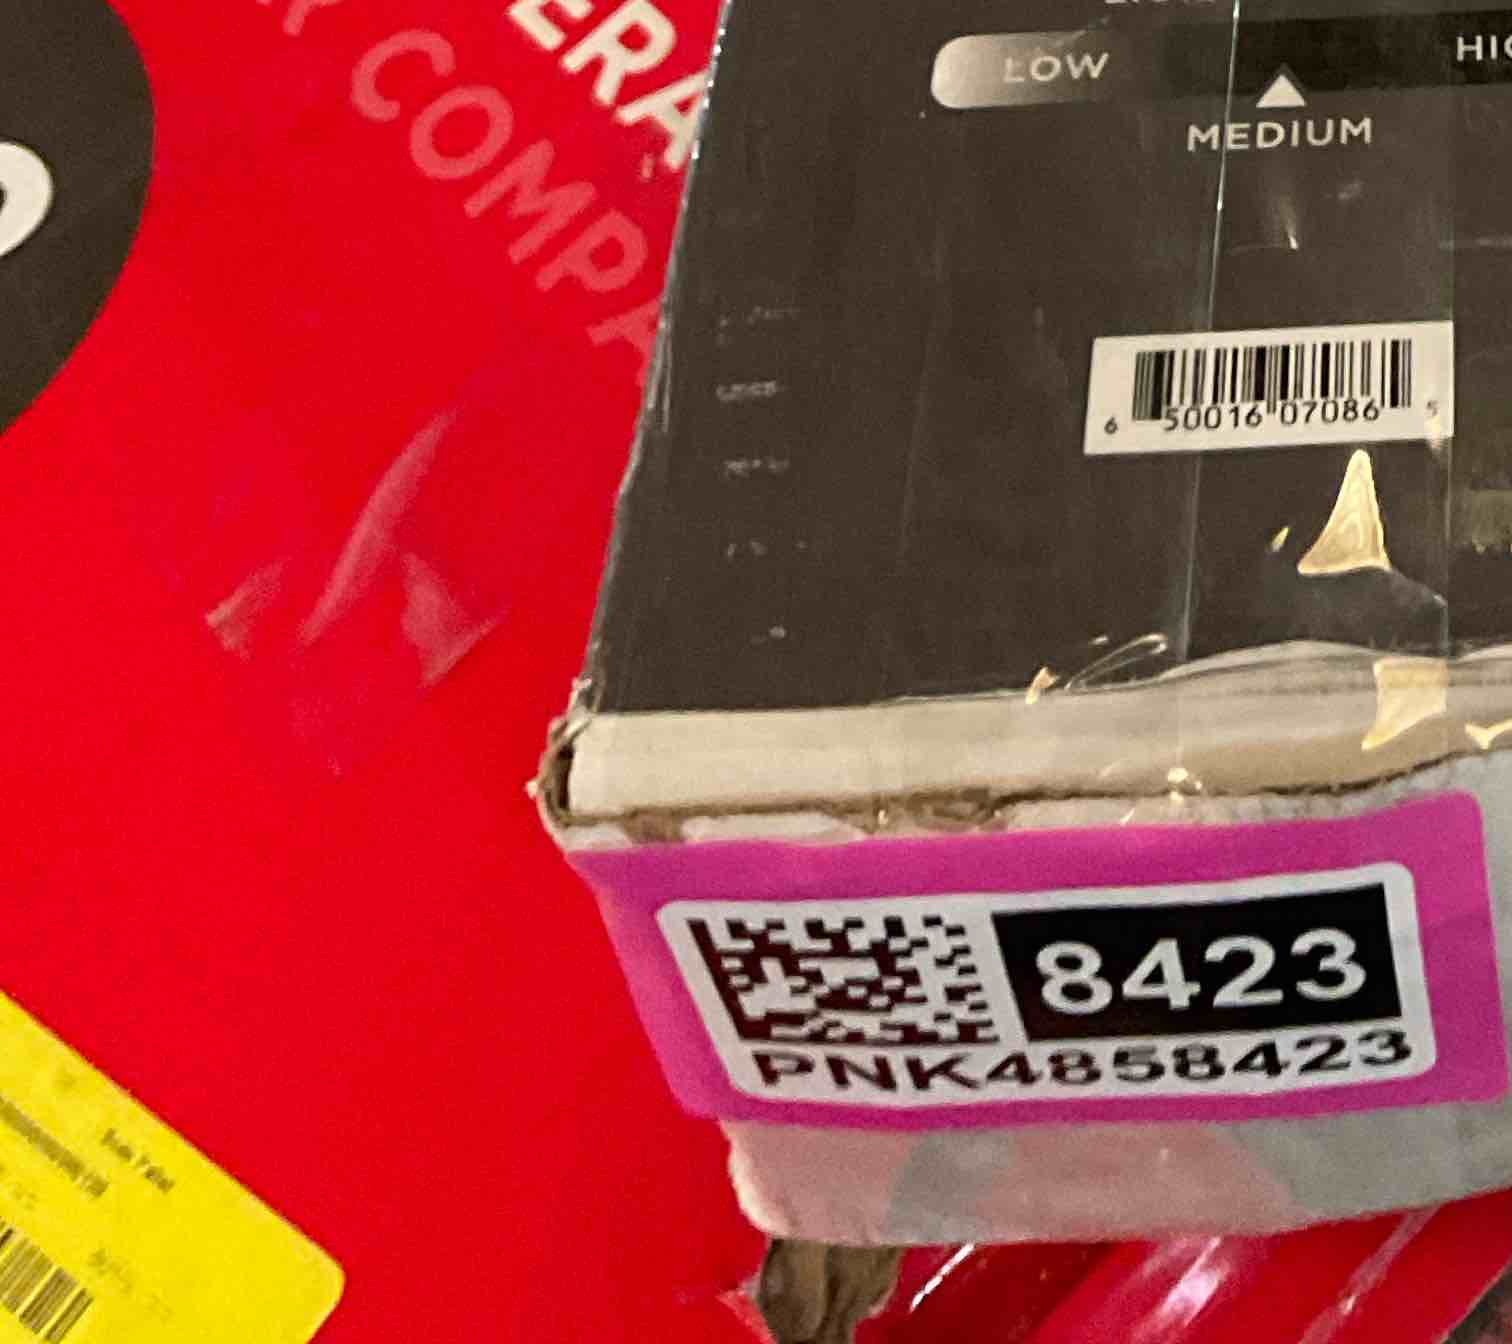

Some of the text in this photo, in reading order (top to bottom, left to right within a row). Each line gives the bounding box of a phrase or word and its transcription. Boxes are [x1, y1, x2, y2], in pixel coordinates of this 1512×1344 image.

[1002, 51, 1111, 85] LOW
[1186, 116, 1374, 155] MEDIUM
[1103, 415, 1119, 436] 6
[1035, 925, 1369, 1015] 8423
[752, 1026, 1414, 1092] PNK4858423
